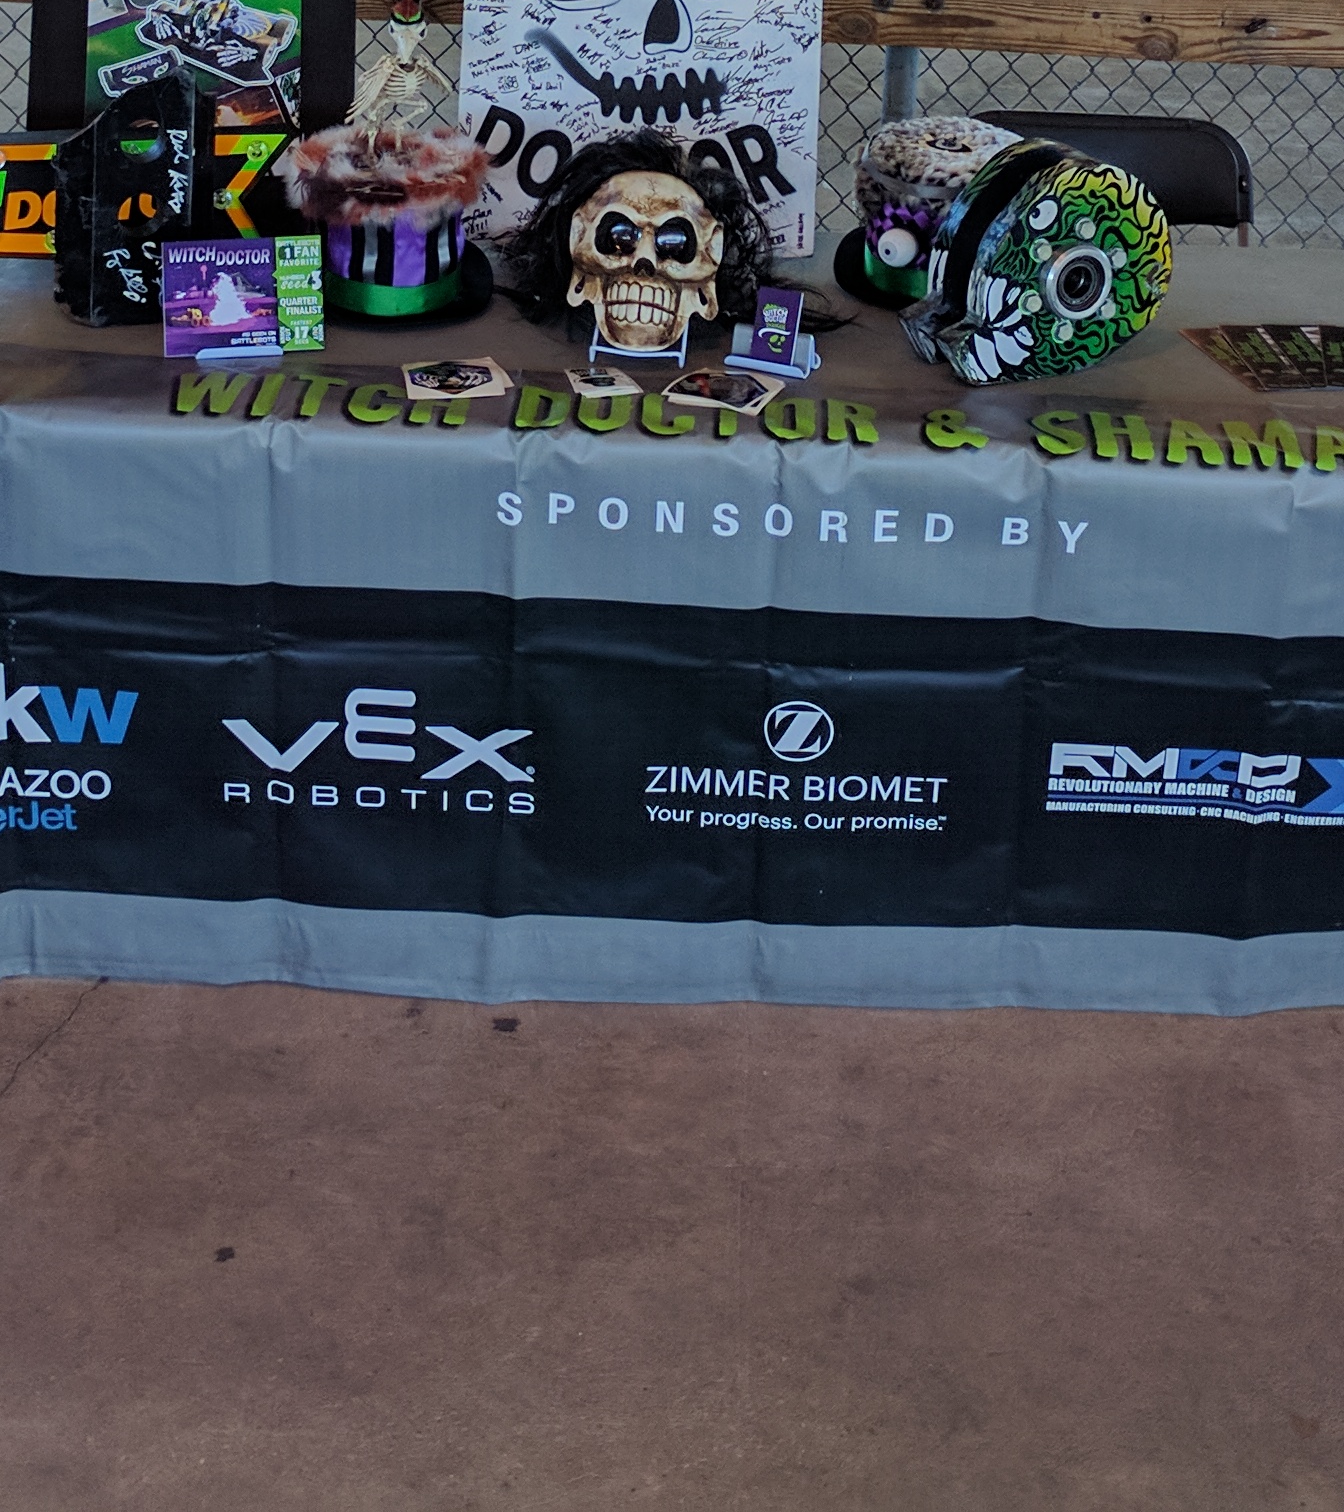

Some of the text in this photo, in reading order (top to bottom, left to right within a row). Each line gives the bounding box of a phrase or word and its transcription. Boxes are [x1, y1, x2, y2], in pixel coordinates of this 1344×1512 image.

[168, 246, 271, 267] WITCH DOCTOR
[279, 257, 319, 267] FAVORITE
[294, 246, 319, 258] FAN
[279, 296, 318, 307] QUARTER
[286, 305, 323, 316] FINALIST
[294, 326, 310, 339] 17
[173, 370, 472, 427] WITCH
[926, 409, 989, 450] &
[496, 491, 1090, 555] SPONSORED BY
[221, 687, 535, 783] VEX
[644, 765, 949, 804] ZIMMER BIOMET
[1047, 777, 1297, 805] REVOLUTIONARY MACHINE & DESIGN
[222, 780, 537, 816] ROBOTICS
[645, 804, 694, 828] Your
[698, 809, 798, 833] progress.
[805, 812, 847, 831] Our
[1045, 800, 1133, 814] MANUFACTURING
[1133, 802, 1197, 817] CONSULTING
[1199, 804, 1222, 818] CNC
[1223, 808, 1282, 825] MACHINING
